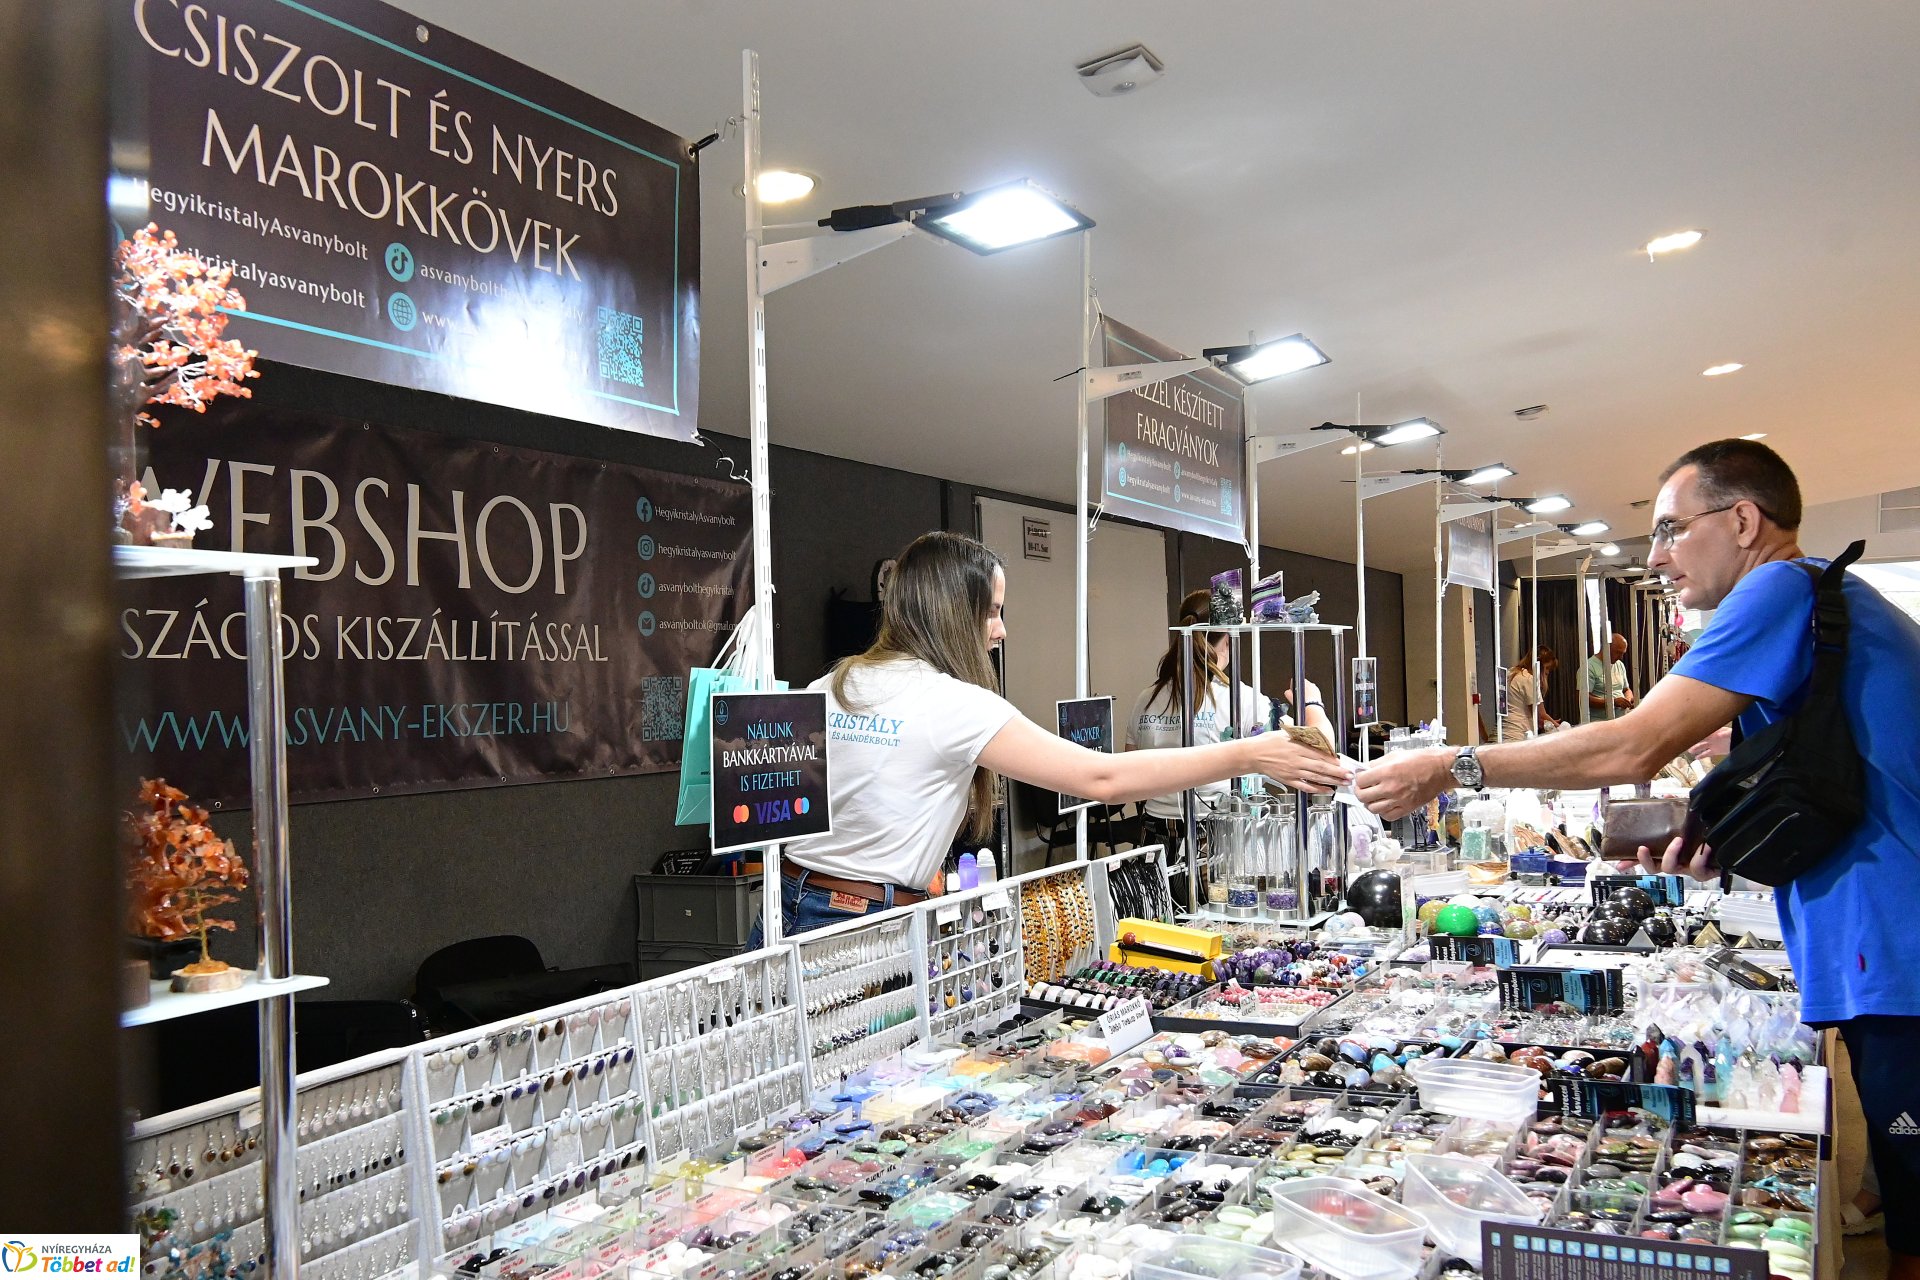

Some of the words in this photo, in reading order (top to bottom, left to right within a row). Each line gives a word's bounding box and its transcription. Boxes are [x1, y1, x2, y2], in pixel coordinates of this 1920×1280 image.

[132, 0, 411, 139] CSISZOLT
[427, 90, 474, 165] ÉS
[492, 124, 619, 218] NYERS
[202, 108, 583, 282] MAROKKÖVEK
[1173, 383, 1225, 431] KÉSZÍTETT
[1137, 412, 1220, 468] FARAGVÁNYOK
[337, 607, 610, 663] KISZÁLLÍTÁSSAL
[747, 719, 794, 740] NÁLUNK
[1071, 726, 1101, 743] NAGYKER
[723, 744, 818, 768] BANKKÁRTYÁVAL
[740, 775, 749, 792] IS
[752, 769, 802, 791] FIZETHET
[754, 799, 792, 824] VISA
